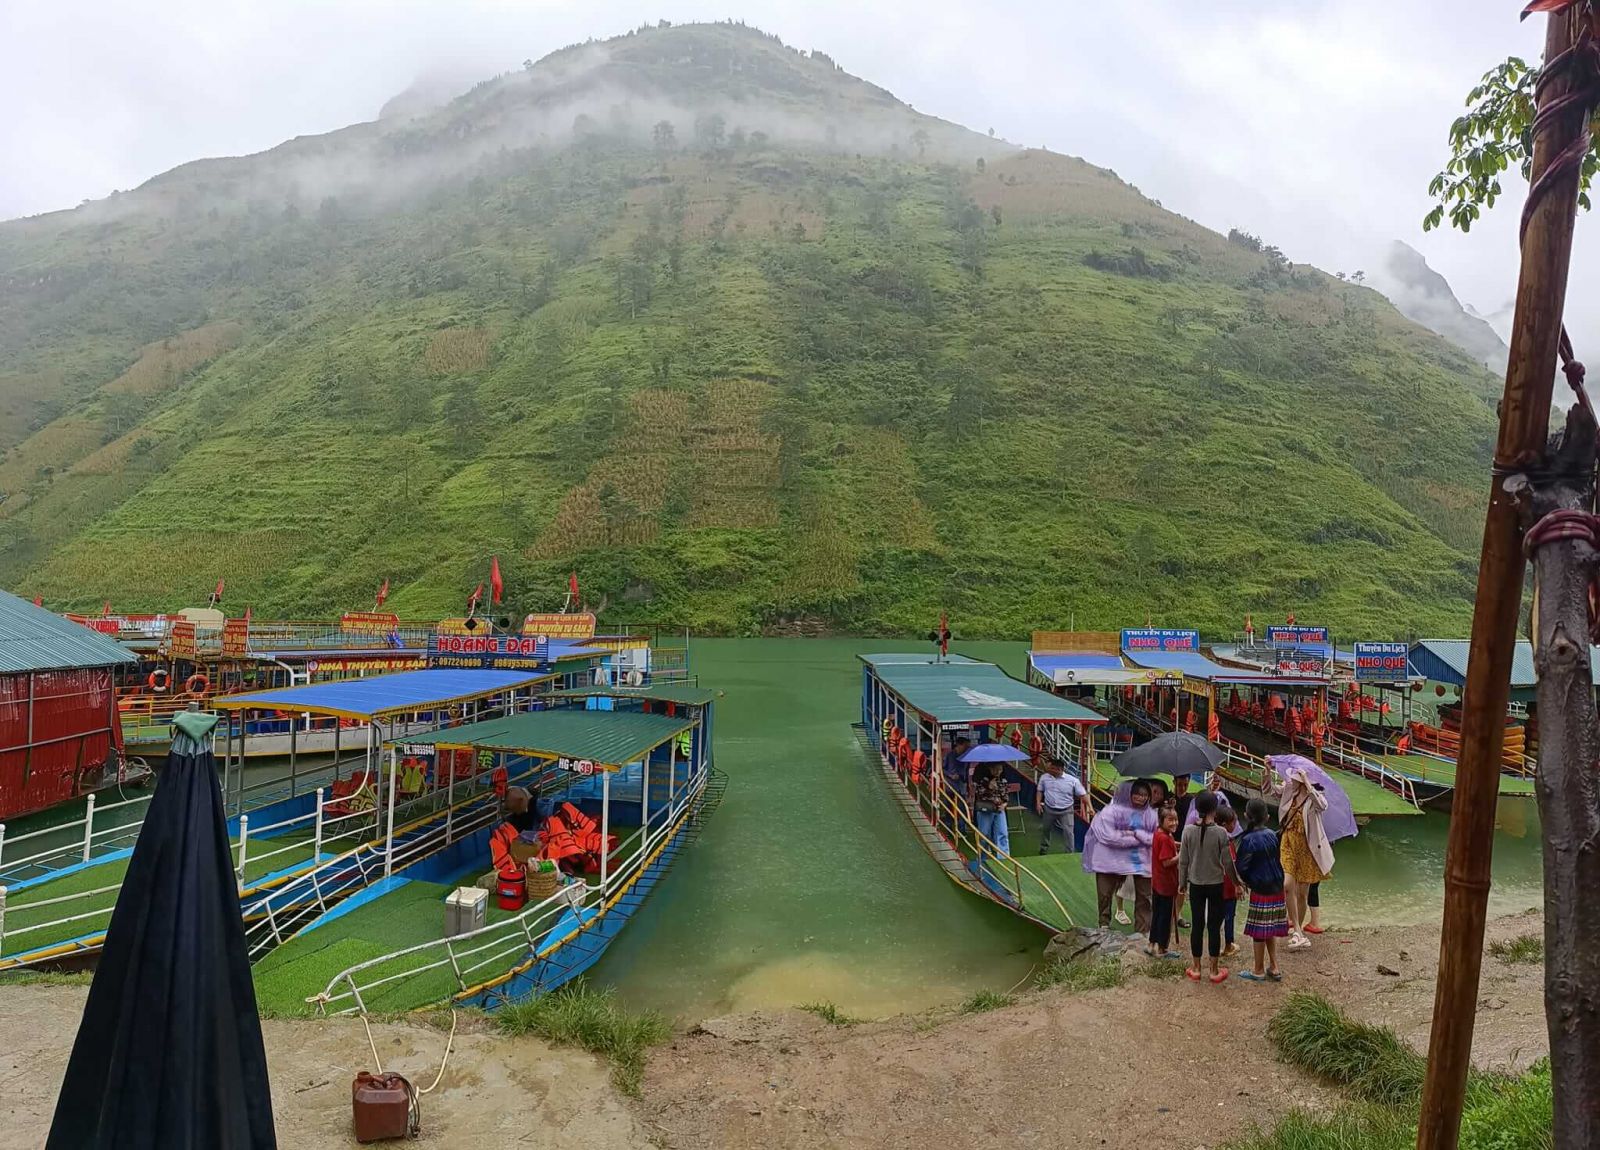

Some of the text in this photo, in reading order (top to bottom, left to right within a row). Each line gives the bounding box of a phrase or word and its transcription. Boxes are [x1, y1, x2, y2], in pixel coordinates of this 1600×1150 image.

[506, 638, 537, 656] ĐẠI
[1129, 637, 1160, 647] NHO
[1382, 644, 1391, 652] Du
[318, 661, 343, 671] NHÀ
[346, 660, 389, 670] THUYỀN
[391, 660, 404, 668] TU
[1357, 653, 1407, 670] NHO QUẾ
